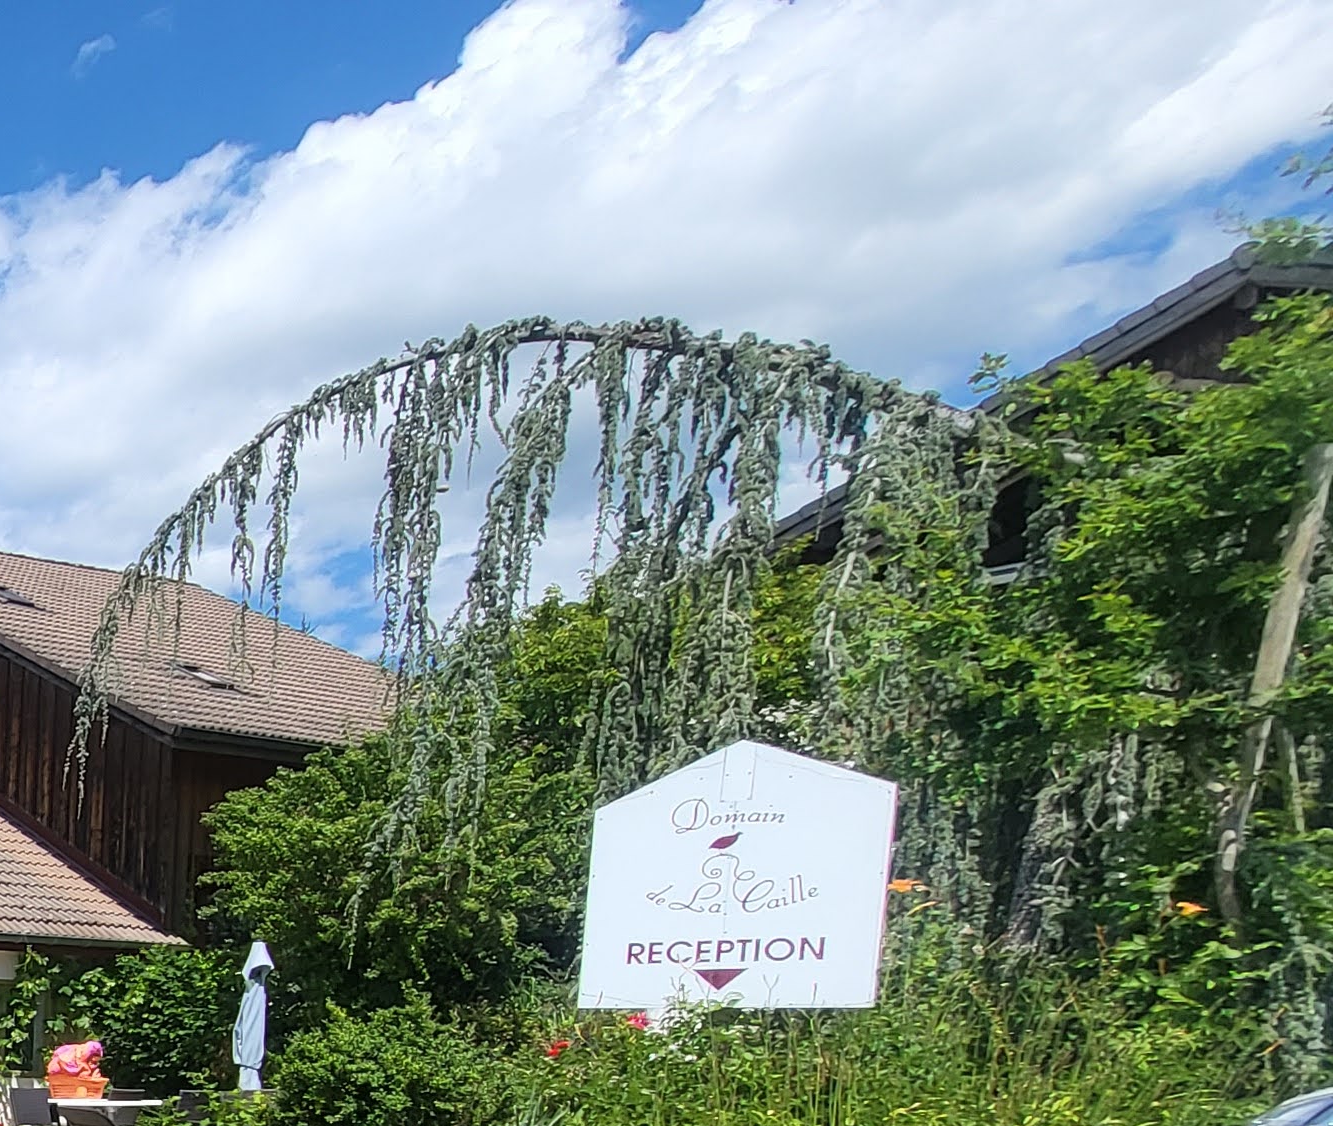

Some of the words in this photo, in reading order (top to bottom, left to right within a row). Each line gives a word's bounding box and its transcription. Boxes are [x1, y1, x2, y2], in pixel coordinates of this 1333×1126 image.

[672, 798, 786, 834] Domain
[646, 885, 673, 906] de
[668, 882, 723, 913] La
[733, 872, 819, 913] Caille
[626, 937, 826, 964] RECEPTION
